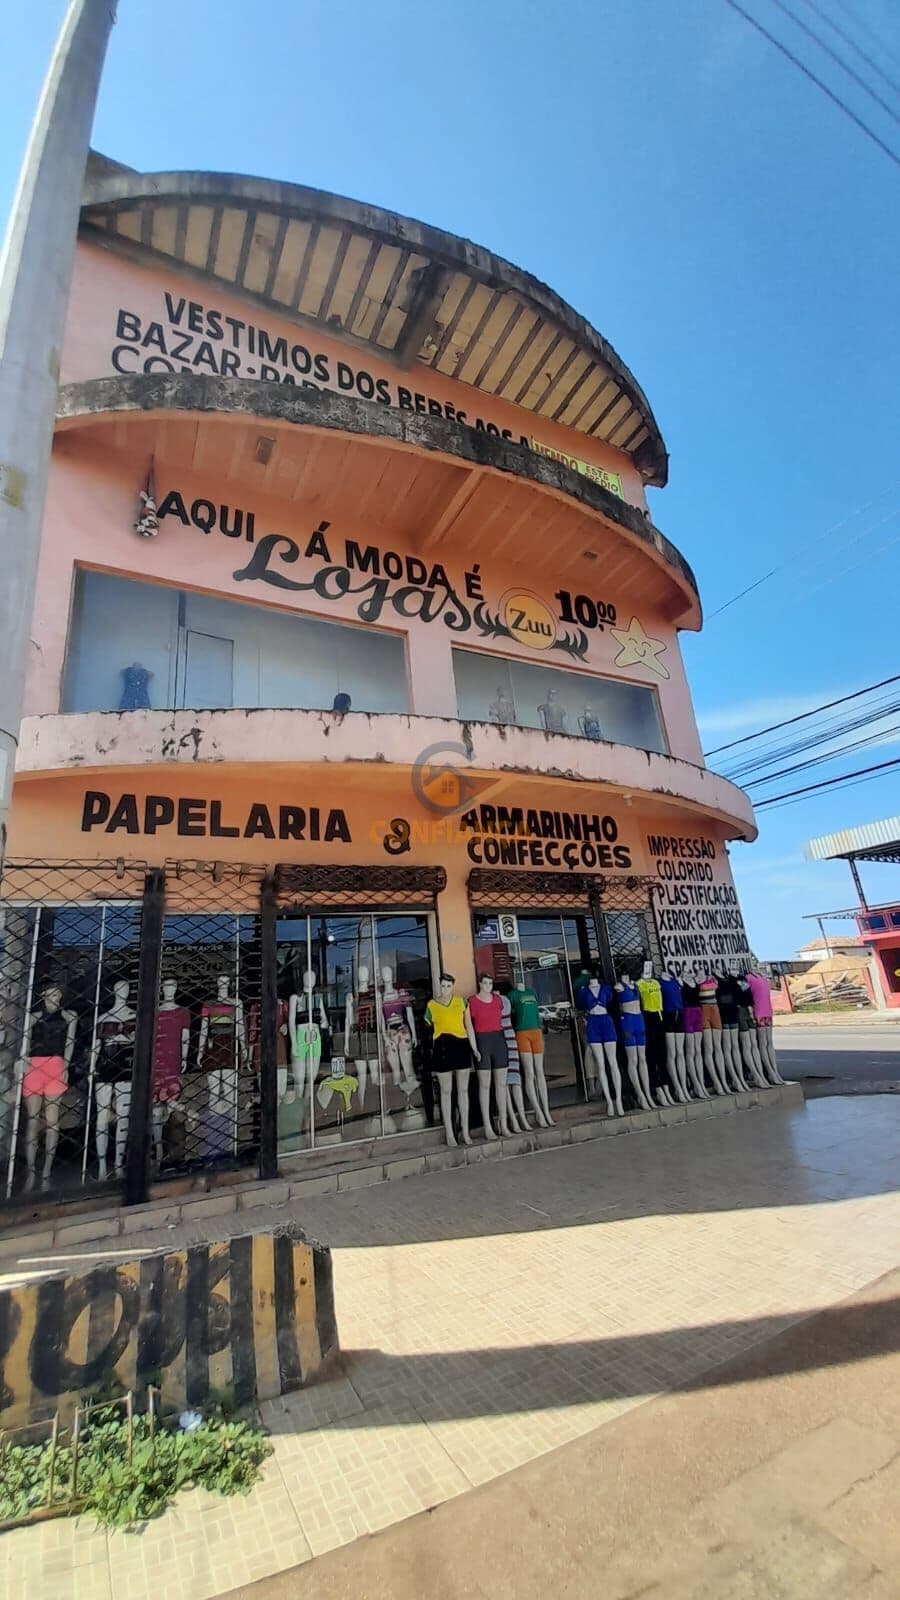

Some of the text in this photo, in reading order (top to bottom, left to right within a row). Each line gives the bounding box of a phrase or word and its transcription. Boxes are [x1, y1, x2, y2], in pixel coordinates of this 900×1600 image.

[116, 309, 241, 377] BAZAR
[164, 292, 330, 382] VESTIMOS
[336, 361, 392, 405] DOS
[156, 490, 256, 542] AQUI
[304, 521, 332, 562] Á
[345, 540, 452, 589] MODA
[464, 564, 484, 600] É
[232, 534, 553, 637] Lojas Zuu
[81, 790, 352, 843] PAPELARIA
[459, 804, 618, 842] ARMARINHO
[467, 837, 632, 869] CONFECÇÕES
[647, 836, 715, 859] IMPRESSÃO
[656, 859, 714, 882] COLORIDO
[656, 883, 737, 907] PLASTIFICAÇÃO
